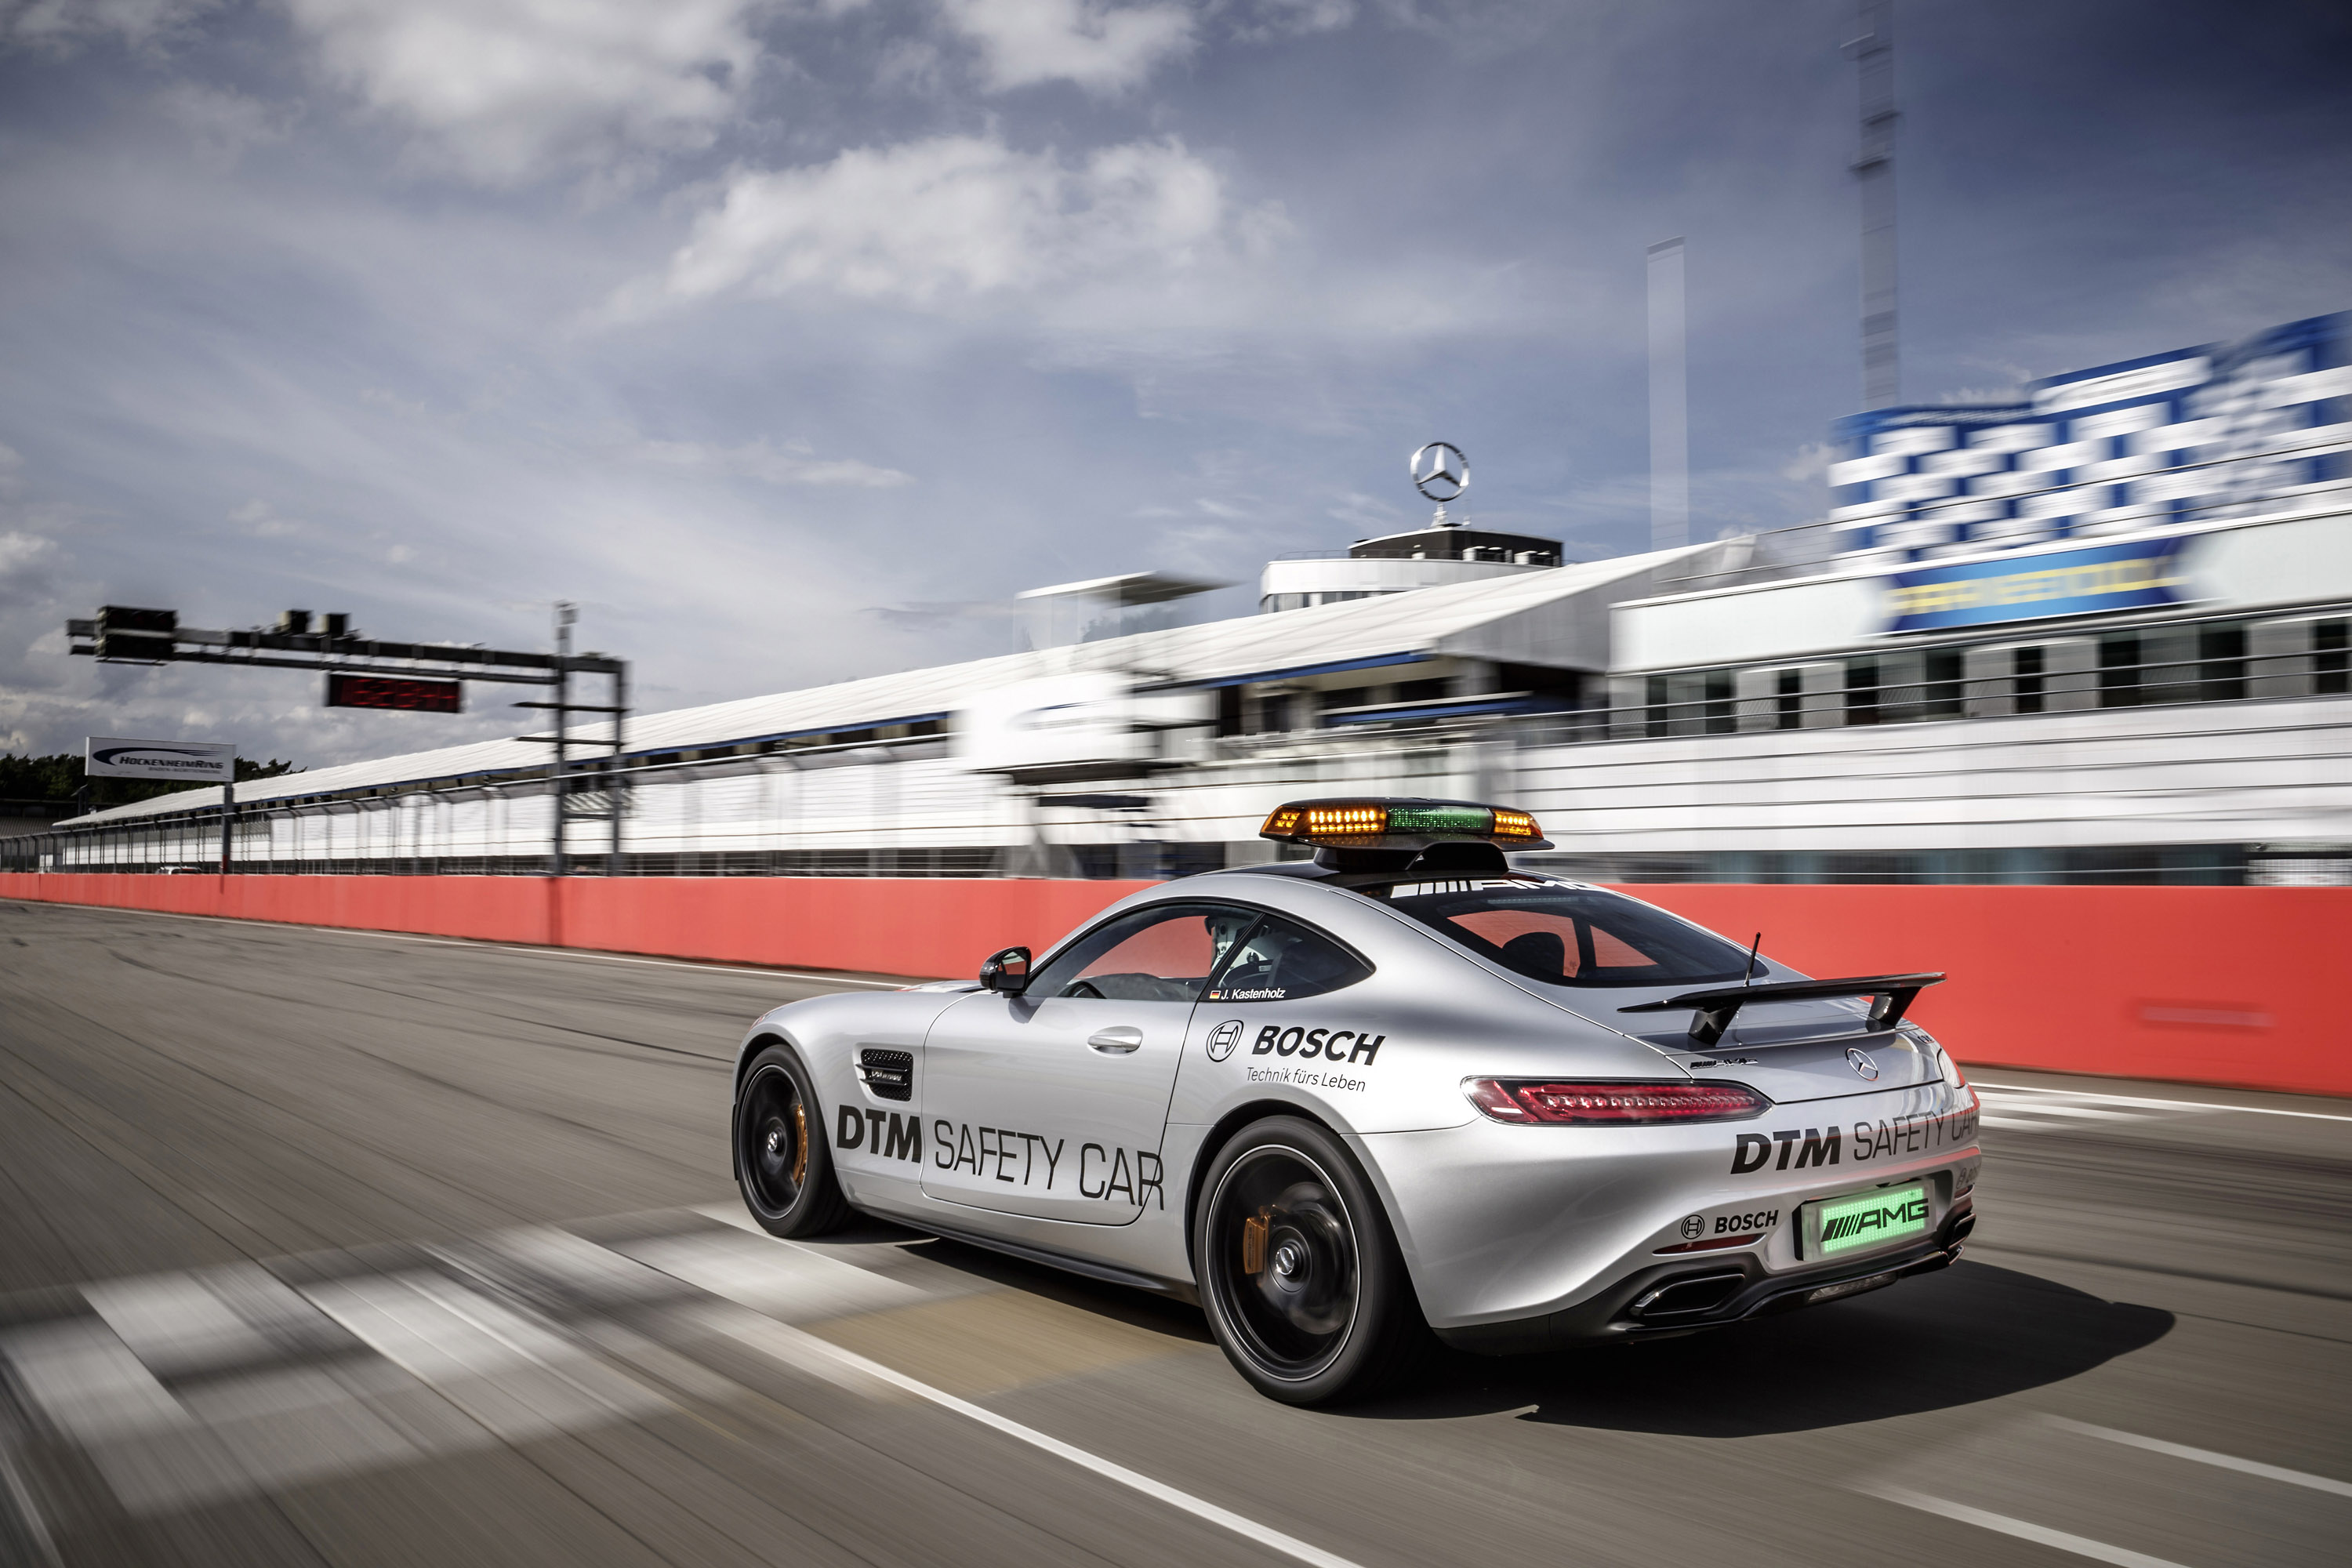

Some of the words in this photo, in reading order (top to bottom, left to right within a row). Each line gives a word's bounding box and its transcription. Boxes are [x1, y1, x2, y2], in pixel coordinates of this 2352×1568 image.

[1221, 989, 1229, 1000] J.
[1232, 987, 1287, 1000] Kastenholz
[1252, 1025, 1386, 1066] BOSCH
[1247, 1066, 1290, 1083] Technik
[1290, 1069, 1319, 1086] fürs
[1321, 1072, 1366, 1092] Leben
[837, 1104, 922, 1163] DTM
[934, 1120, 1065, 1190] SAFETY
[1079, 1142, 1165, 1211] CAR
[1730, 1126, 1842, 1175] DTM
[1853, 1108, 1944, 1161] SAFETY
[1715, 1210, 1779, 1235] BOSCH
[1855, 1197, 1930, 1235] AMG
